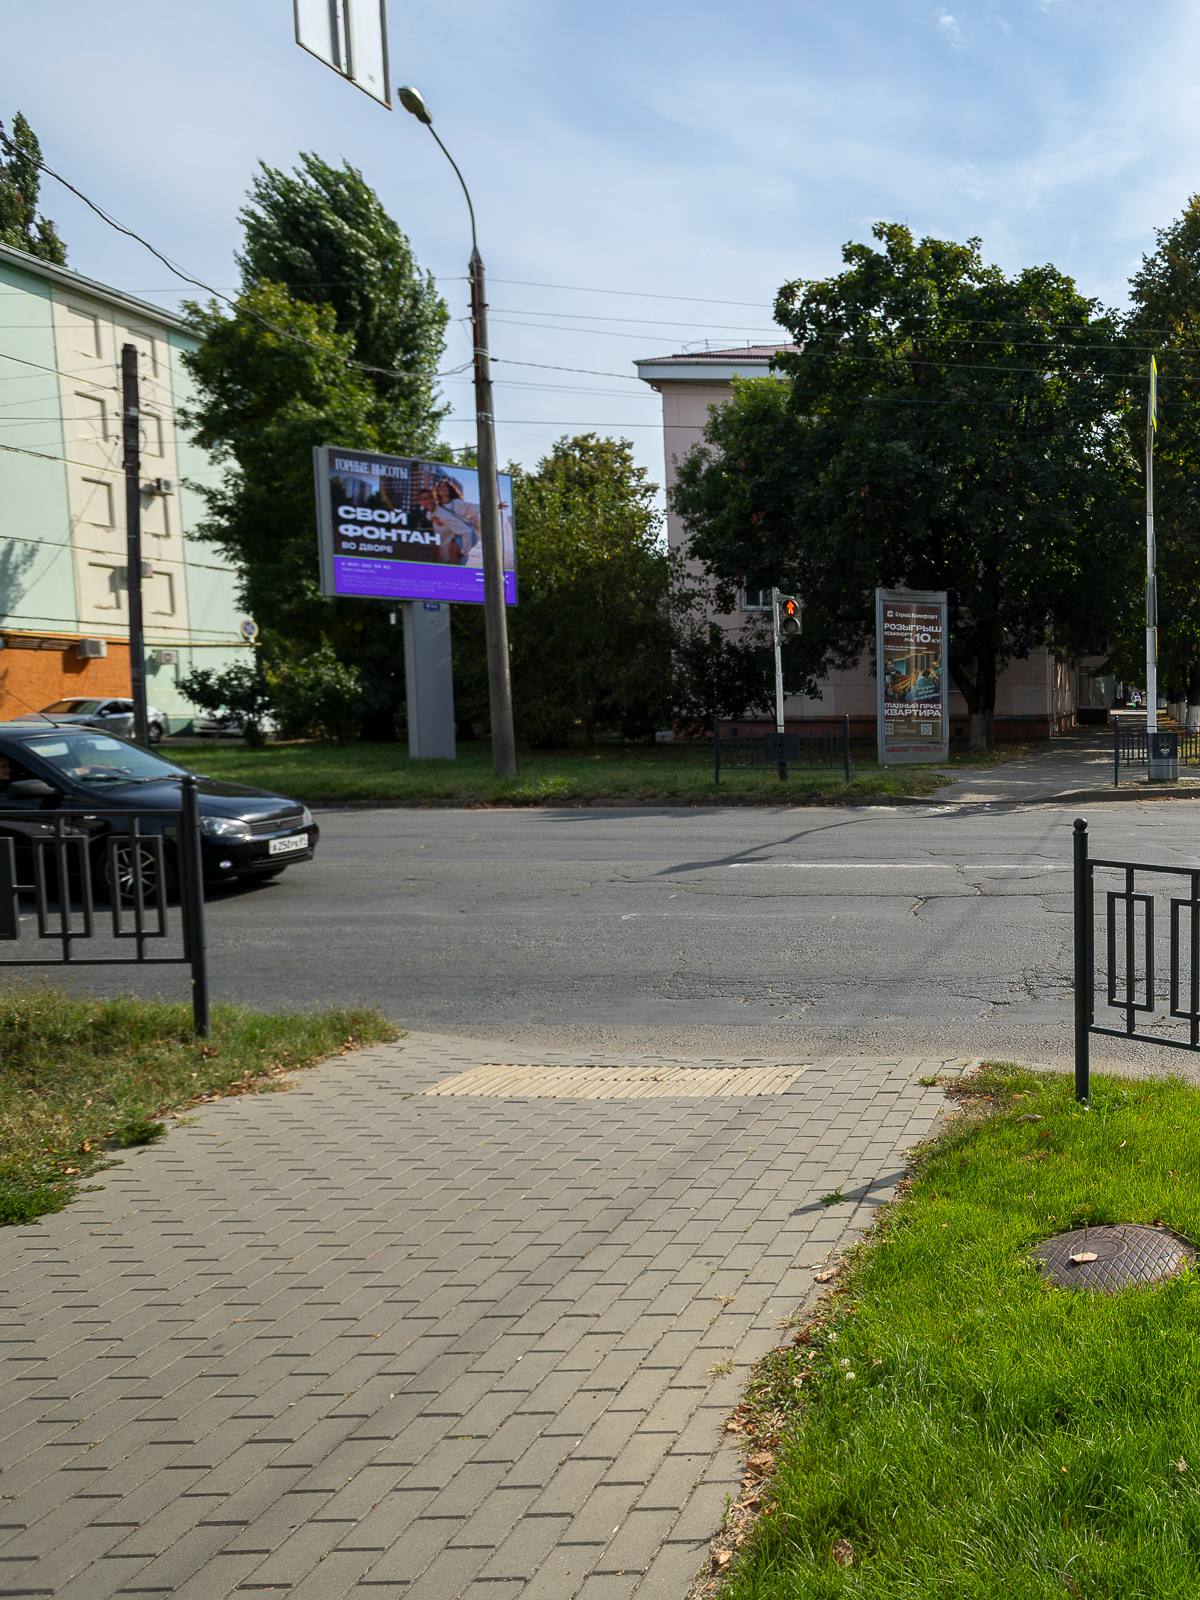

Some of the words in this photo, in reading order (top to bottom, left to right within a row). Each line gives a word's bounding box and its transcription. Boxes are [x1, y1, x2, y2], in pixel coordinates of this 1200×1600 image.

[337, 505, 408, 525] СВОЙ
[338, 524, 441, 545] ФОНТАН
[341, 541, 357, 550] ВО
[358, 543, 393, 554] ДВОРЕ
[884, 623, 942, 632] РОЗЫГРЫШ
[884, 709, 942, 717] КВАРТИРА
